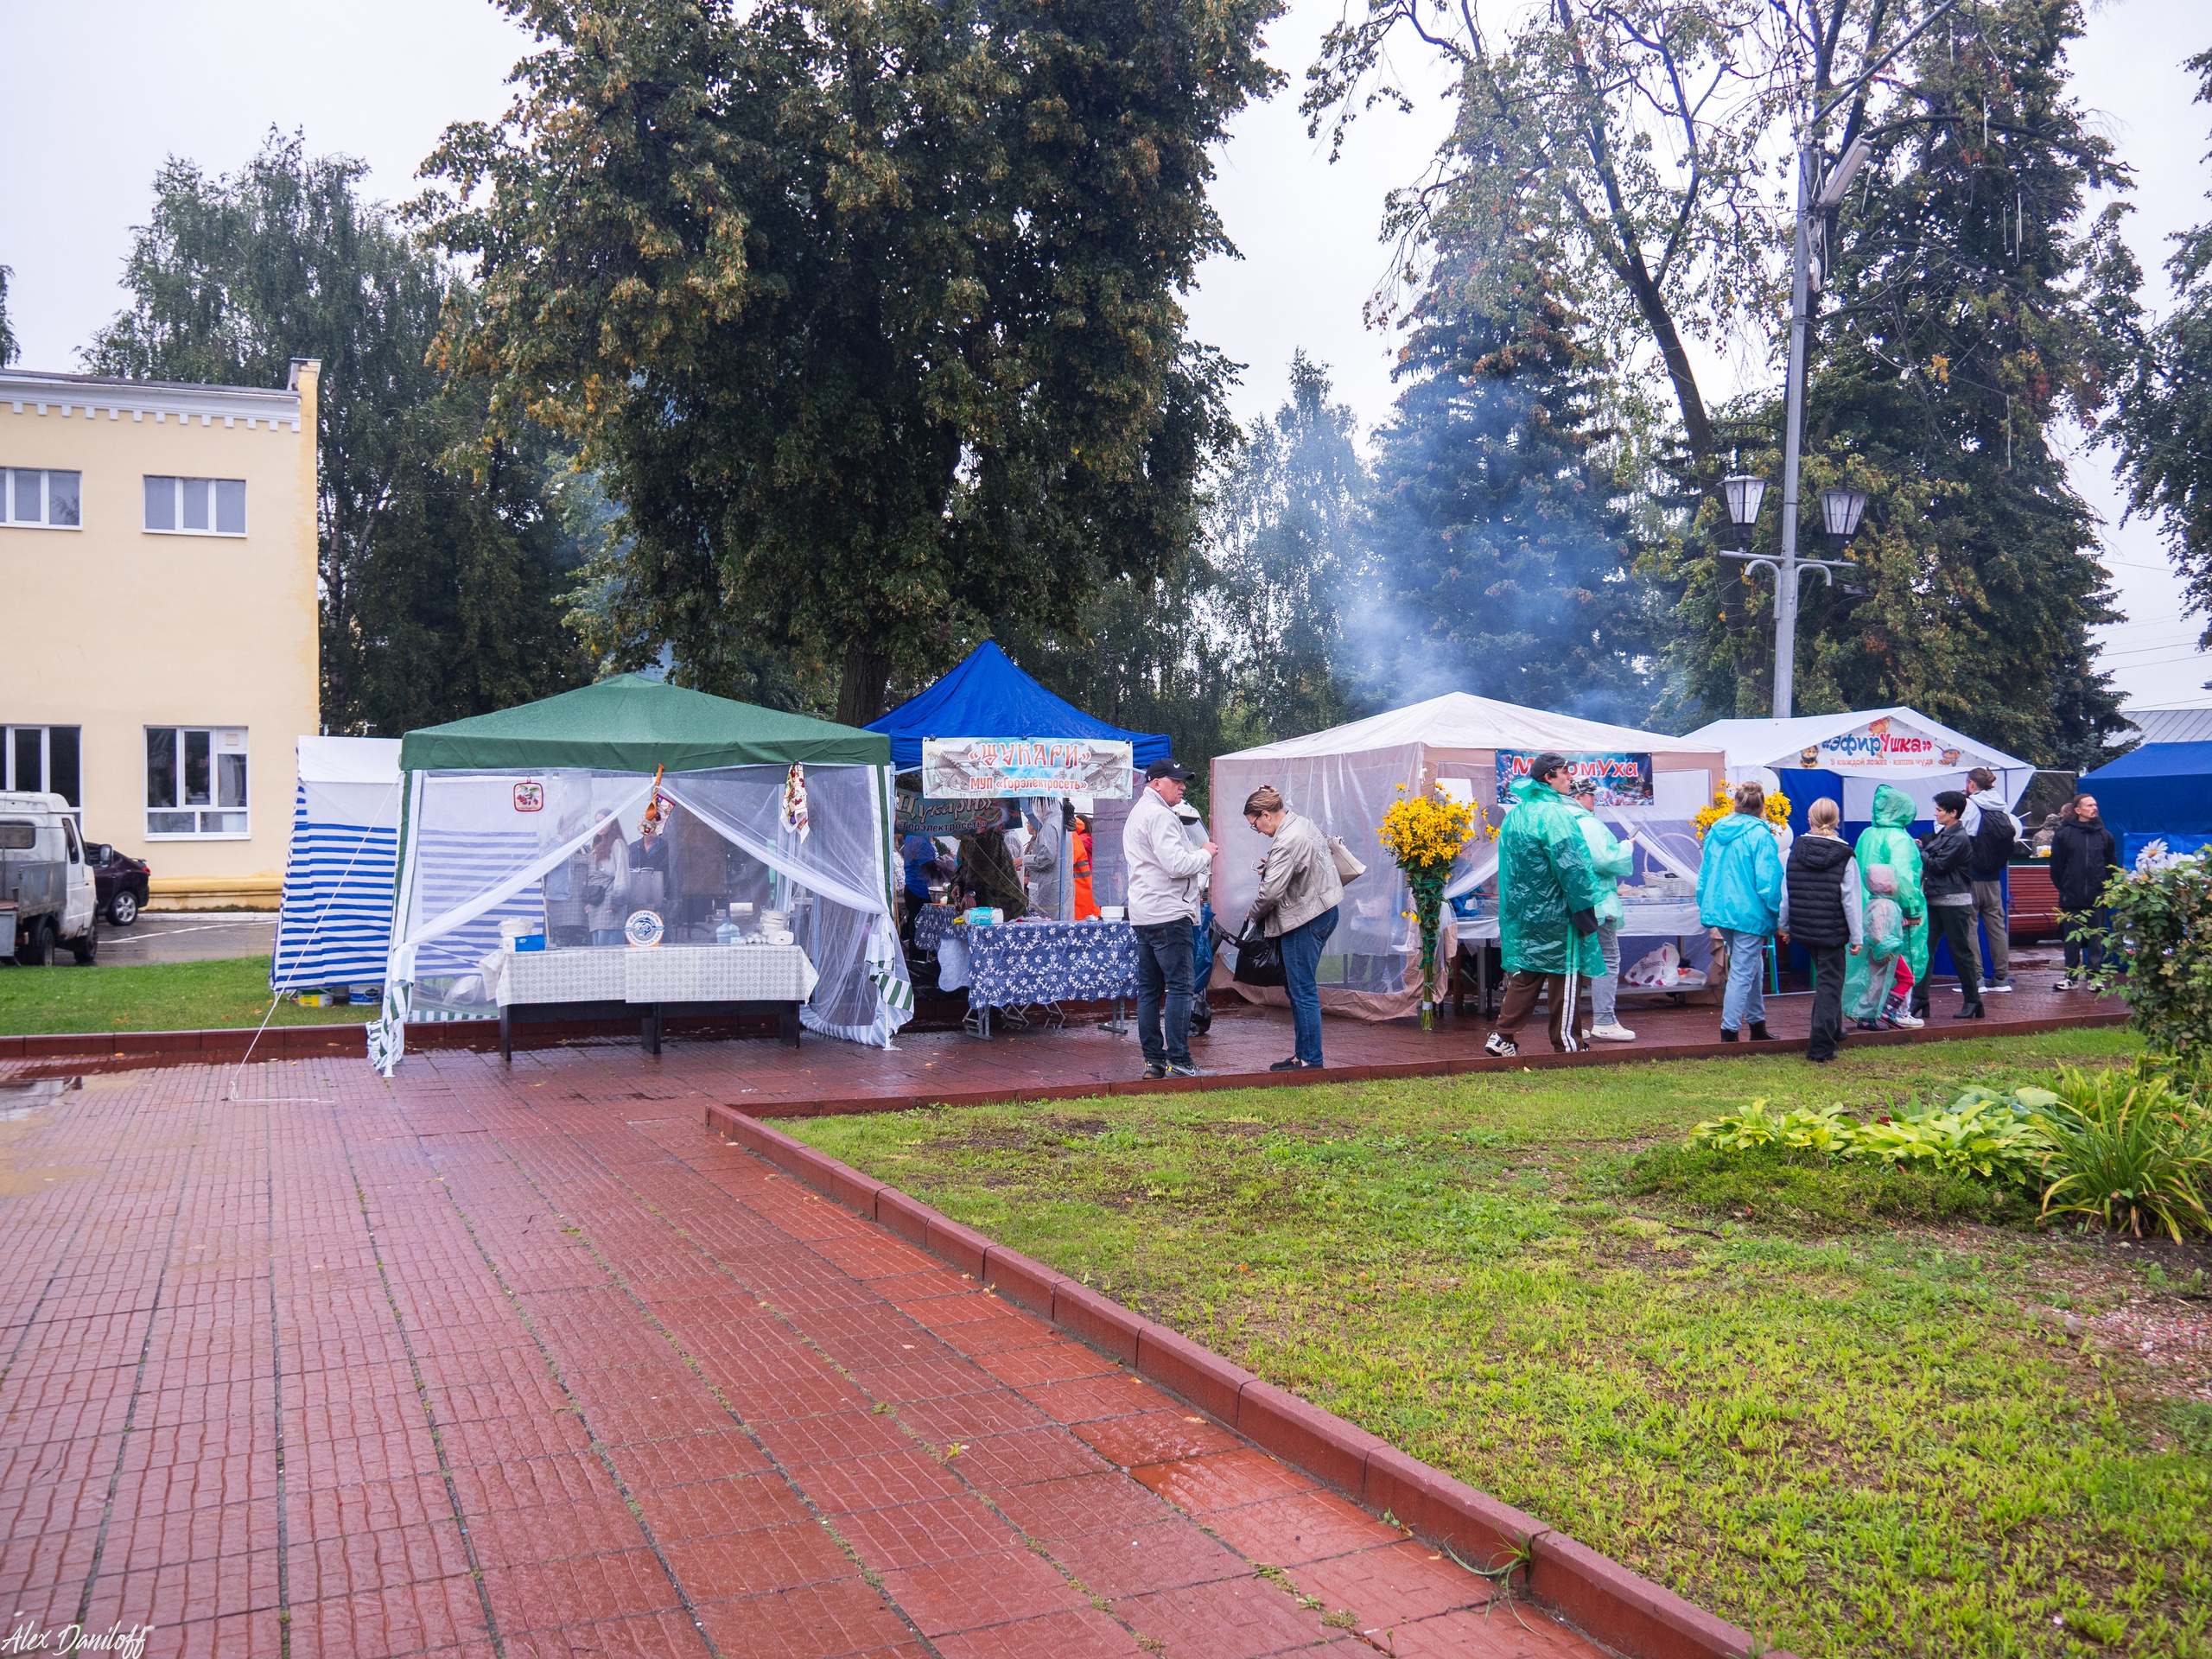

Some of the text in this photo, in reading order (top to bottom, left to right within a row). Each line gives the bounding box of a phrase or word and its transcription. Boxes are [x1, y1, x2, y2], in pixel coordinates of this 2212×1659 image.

[1513, 757, 1638, 777] МомУха
[1837, 758, 1865, 767] каждой
[970, 777, 1087, 791] МУП «Горэлектросеть»
